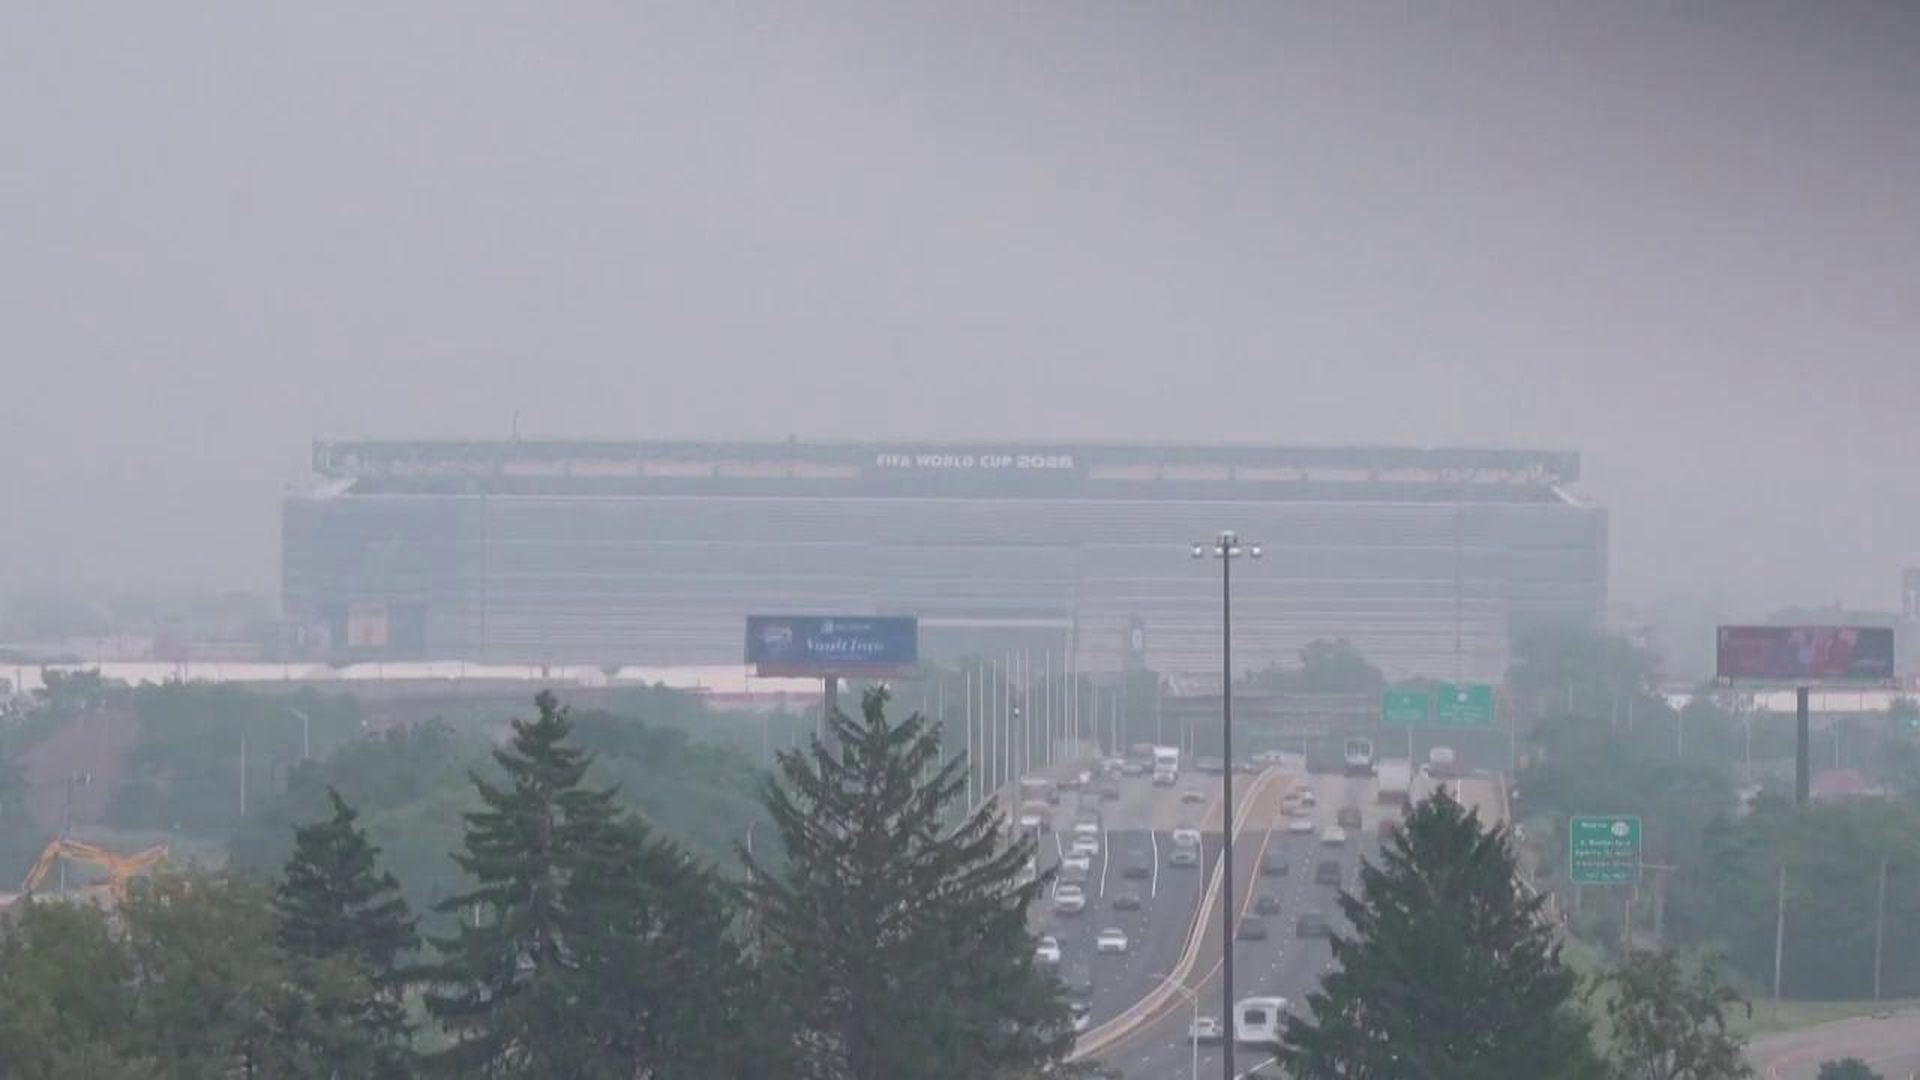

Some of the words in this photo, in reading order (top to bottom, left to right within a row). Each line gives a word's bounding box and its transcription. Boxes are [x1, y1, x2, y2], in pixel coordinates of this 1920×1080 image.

[876, 455, 911, 469] FIFA
[916, 455, 975, 469] WORLD
[979, 455, 1013, 469] CUP
